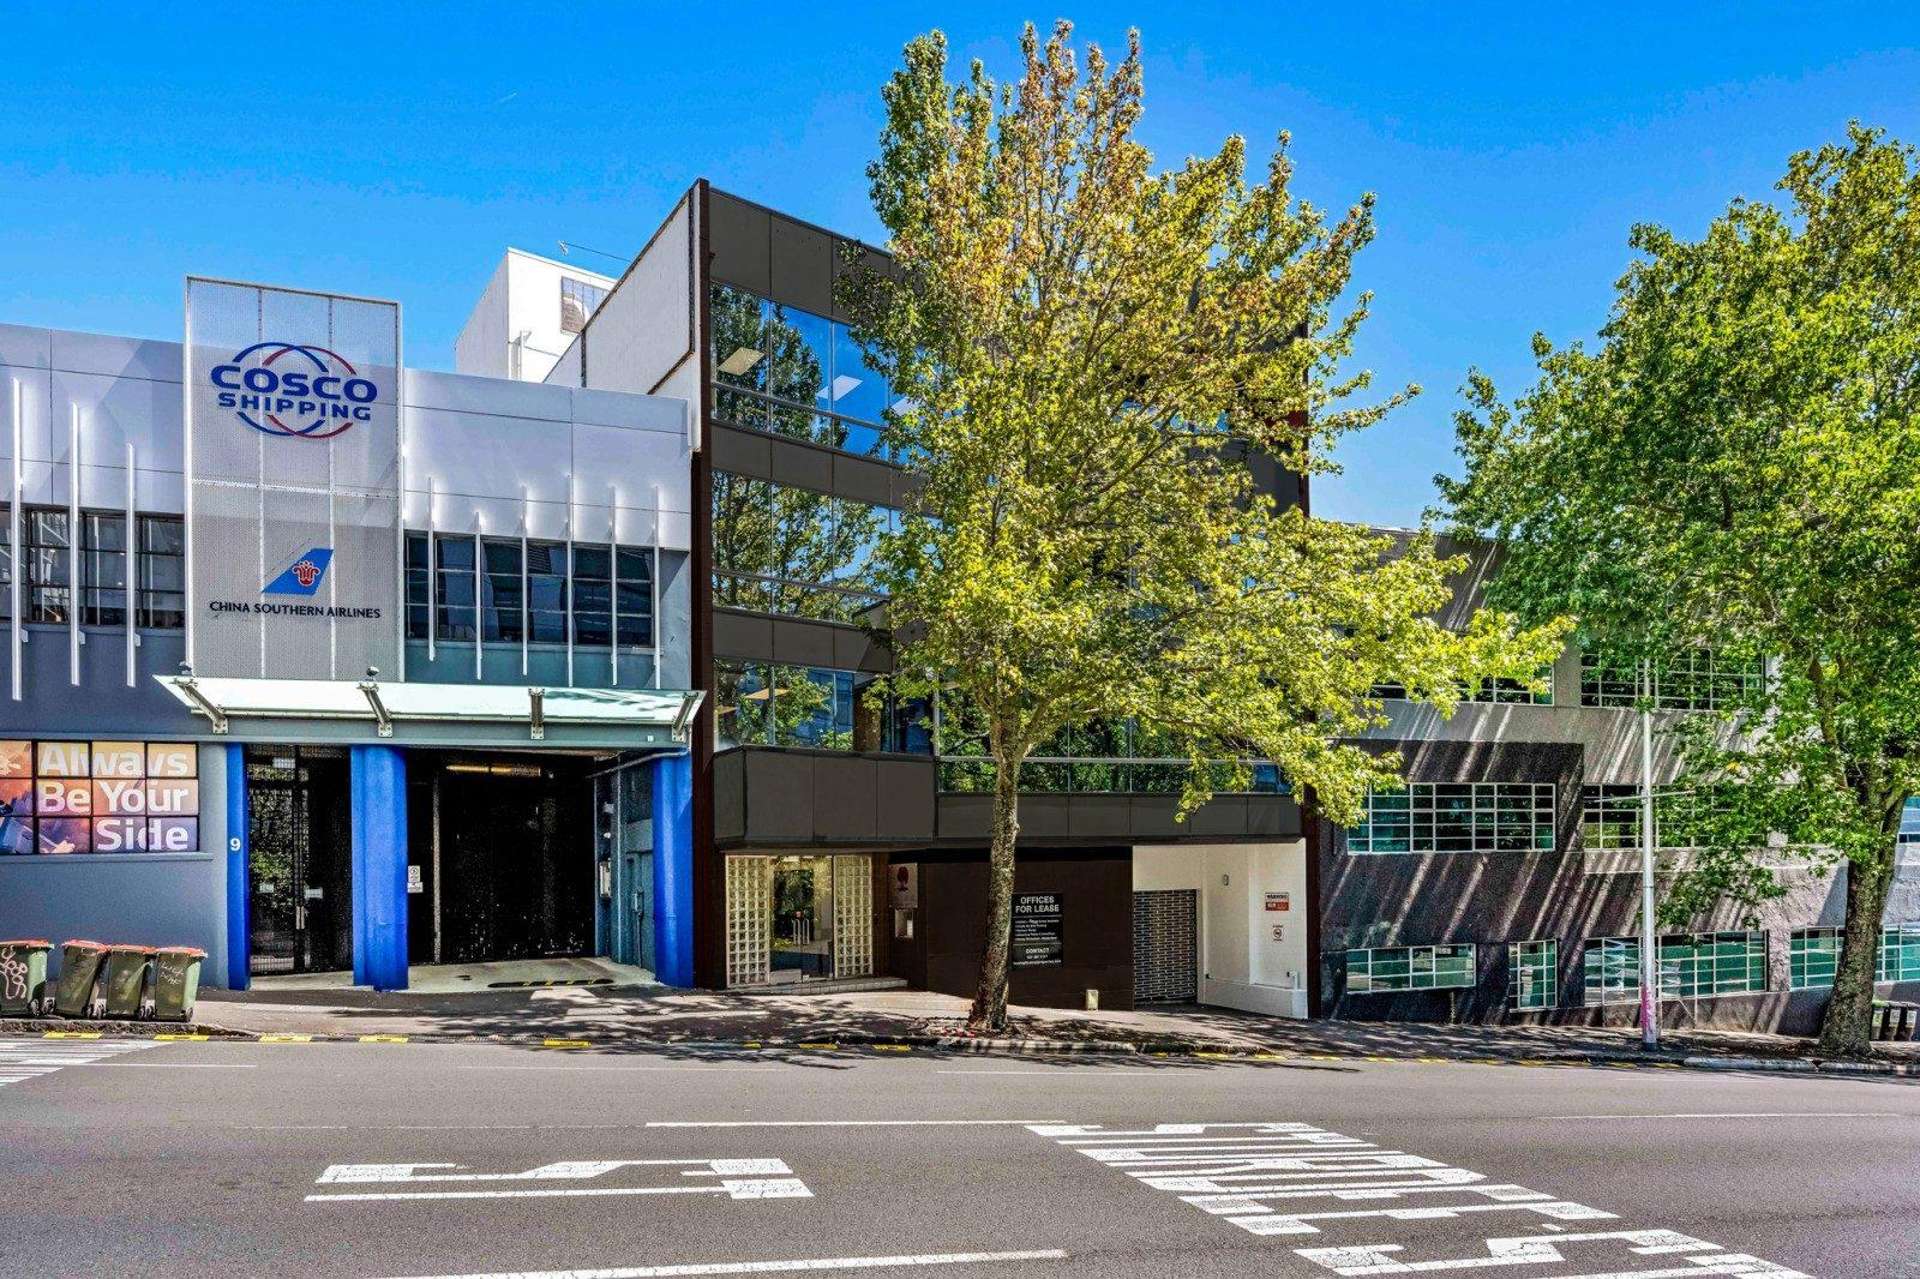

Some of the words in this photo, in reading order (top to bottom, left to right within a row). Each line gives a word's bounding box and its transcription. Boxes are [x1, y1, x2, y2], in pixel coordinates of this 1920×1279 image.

[210, 365, 378, 403] COSCO
[218, 392, 371, 421] SHIPPING
[209, 601, 250, 613] CHINA
[254, 603, 324, 616] SOUTHERN
[327, 606, 381, 619] AIRLINES
[40, 743, 188, 777] Always
[38, 781, 91, 813] Be
[99, 780, 188, 813] Your
[97, 818, 188, 851] Side
[229, 837, 241, 852] 9
[1015, 905, 1032, 913] FOR
[1034, 904, 1060, 912] LEASE
[1020, 896, 1055, 904] OFFICES
